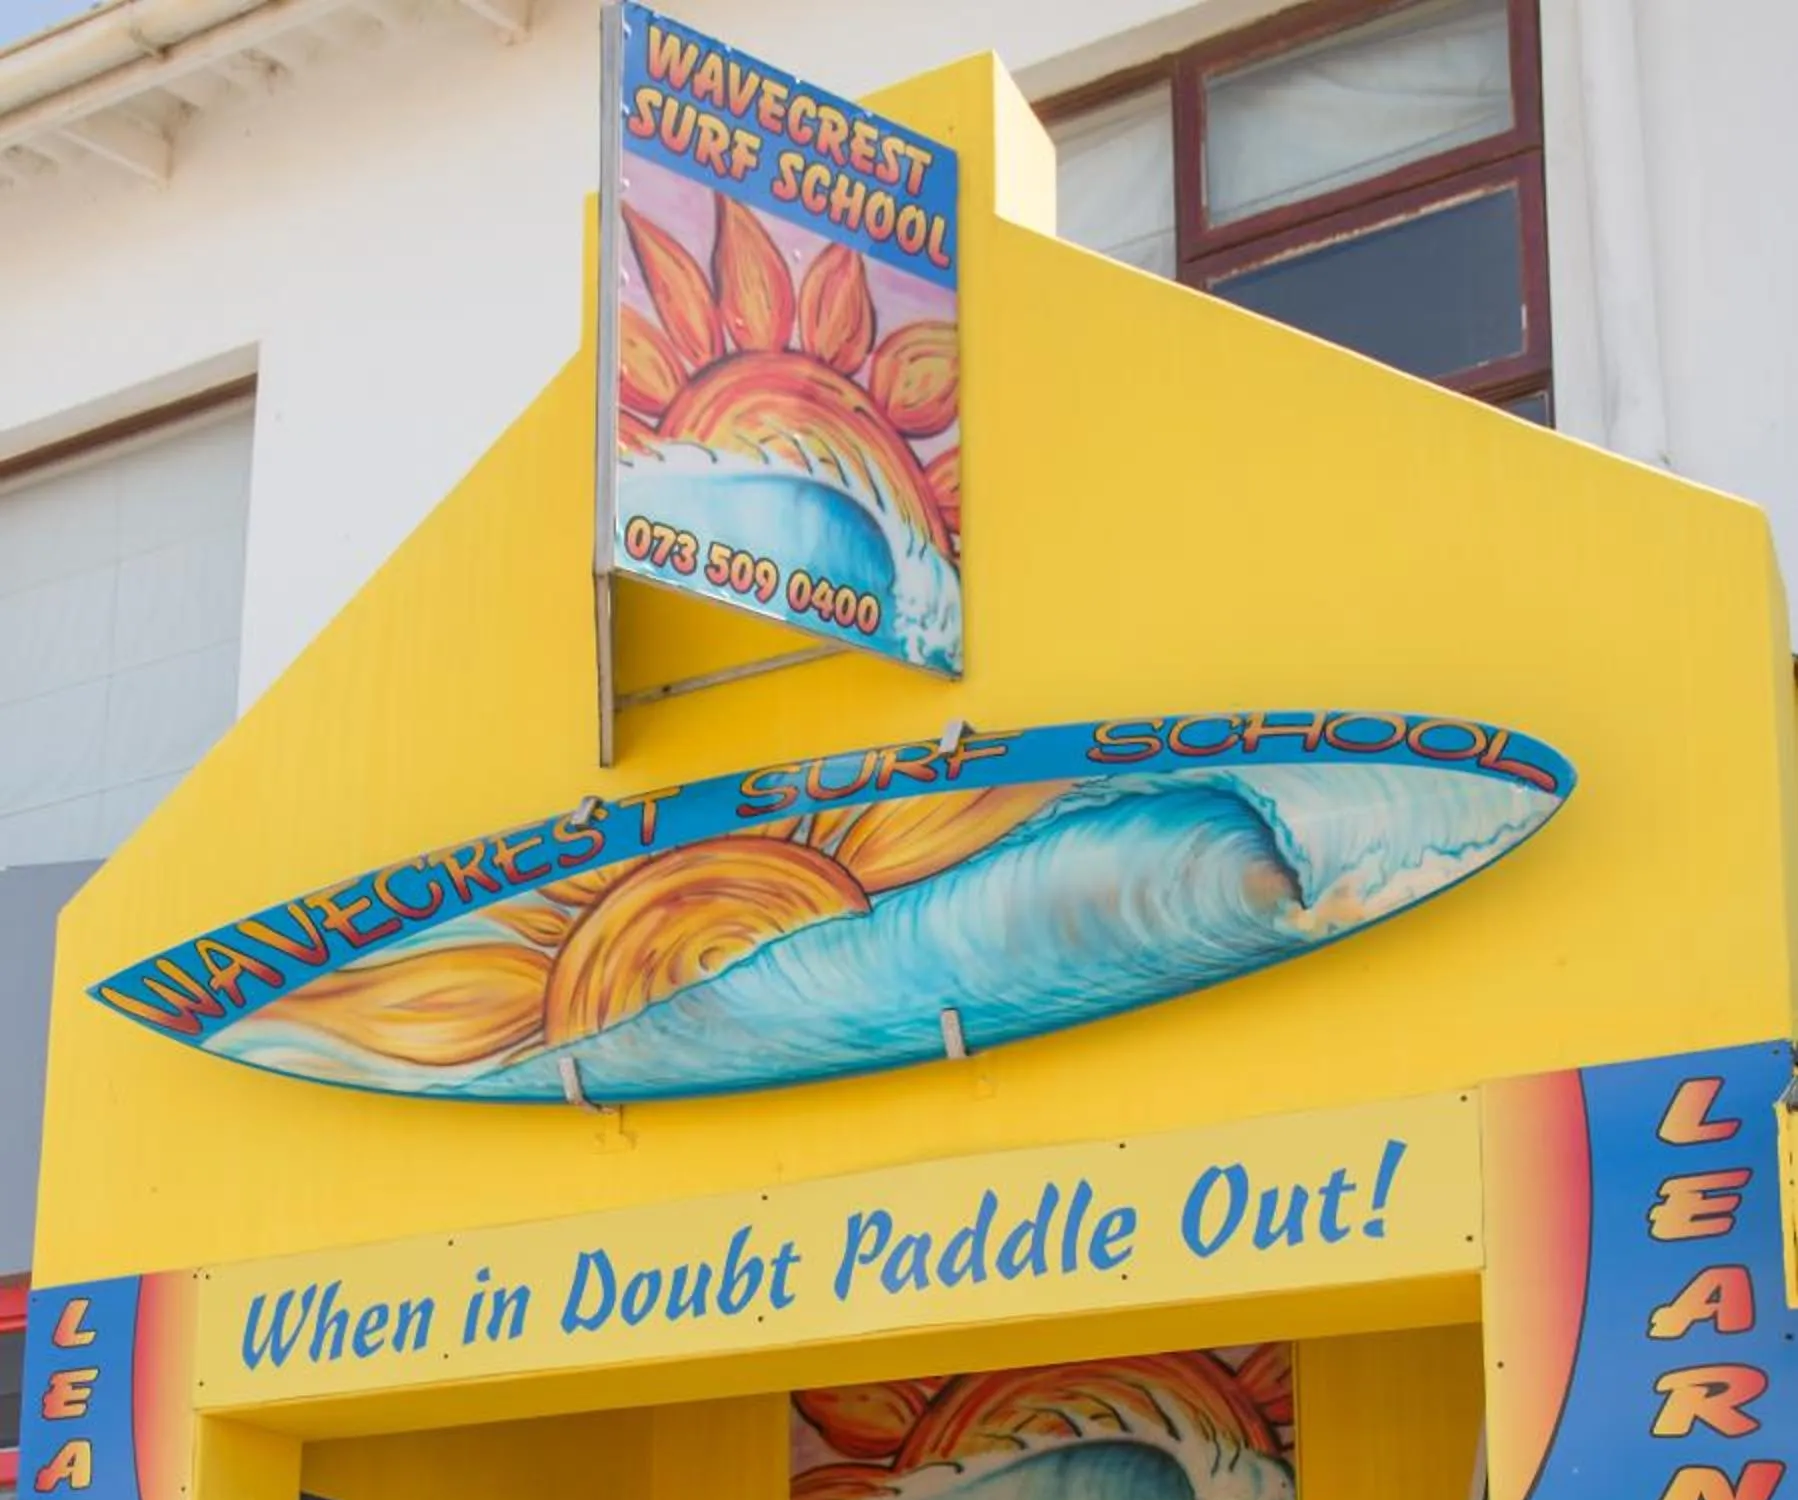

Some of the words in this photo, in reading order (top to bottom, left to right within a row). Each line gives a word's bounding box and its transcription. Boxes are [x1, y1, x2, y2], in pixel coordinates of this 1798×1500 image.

[627, 86, 762, 183] SURF
[771, 152, 950, 270] SCHOOL
[647, 24, 932, 197] WAVECREST
[625, 515, 699, 575] 073
[705, 541, 779, 604] 509
[786, 569, 881, 635] 0400
[99, 784, 685, 1037] WAVECREST
[737, 729, 1023, 817] SURF
[1088, 710, 1558, 794] SCHOOL
[241, 1279, 435, 1371] When
[461, 1267, 531, 1345] in
[560, 1225, 802, 1335] Doubt
[834, 1178, 1137, 1302] Paddle
[1181, 1139, 1408, 1259] Out!
